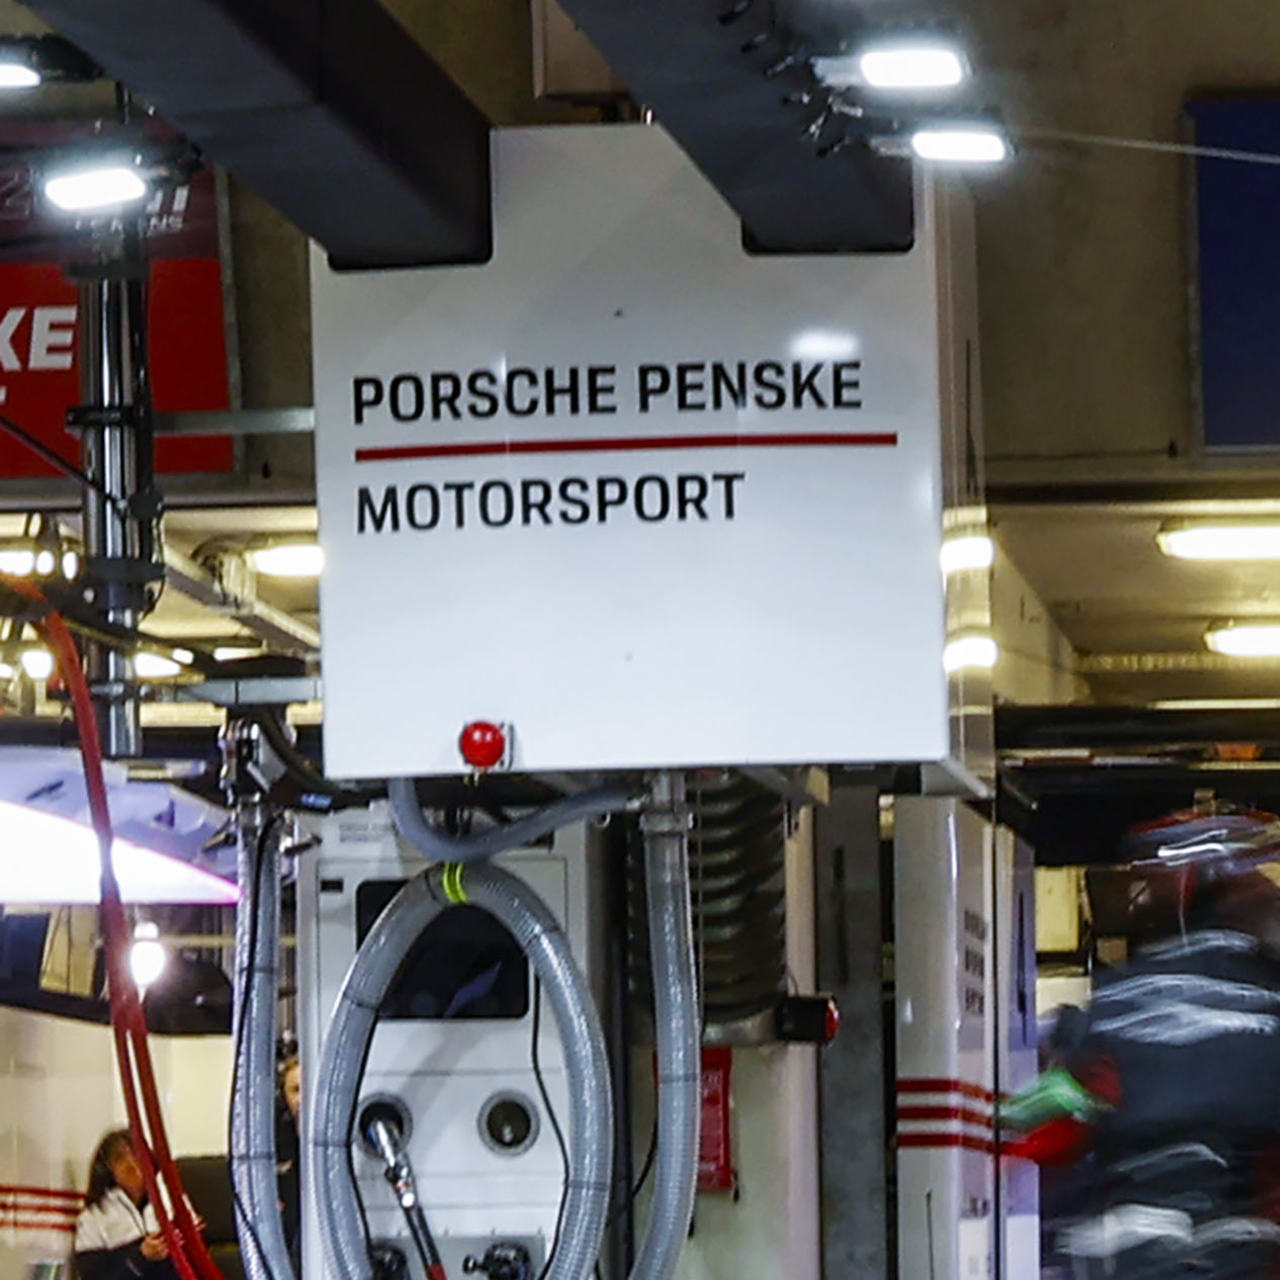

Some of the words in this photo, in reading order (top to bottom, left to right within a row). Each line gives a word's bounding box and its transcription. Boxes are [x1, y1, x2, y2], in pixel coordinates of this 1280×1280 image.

[353, 364, 618, 425] PORSCHE
[637, 360, 863, 415] PENSKE
[356, 472, 746, 535] MOTORSPORT
